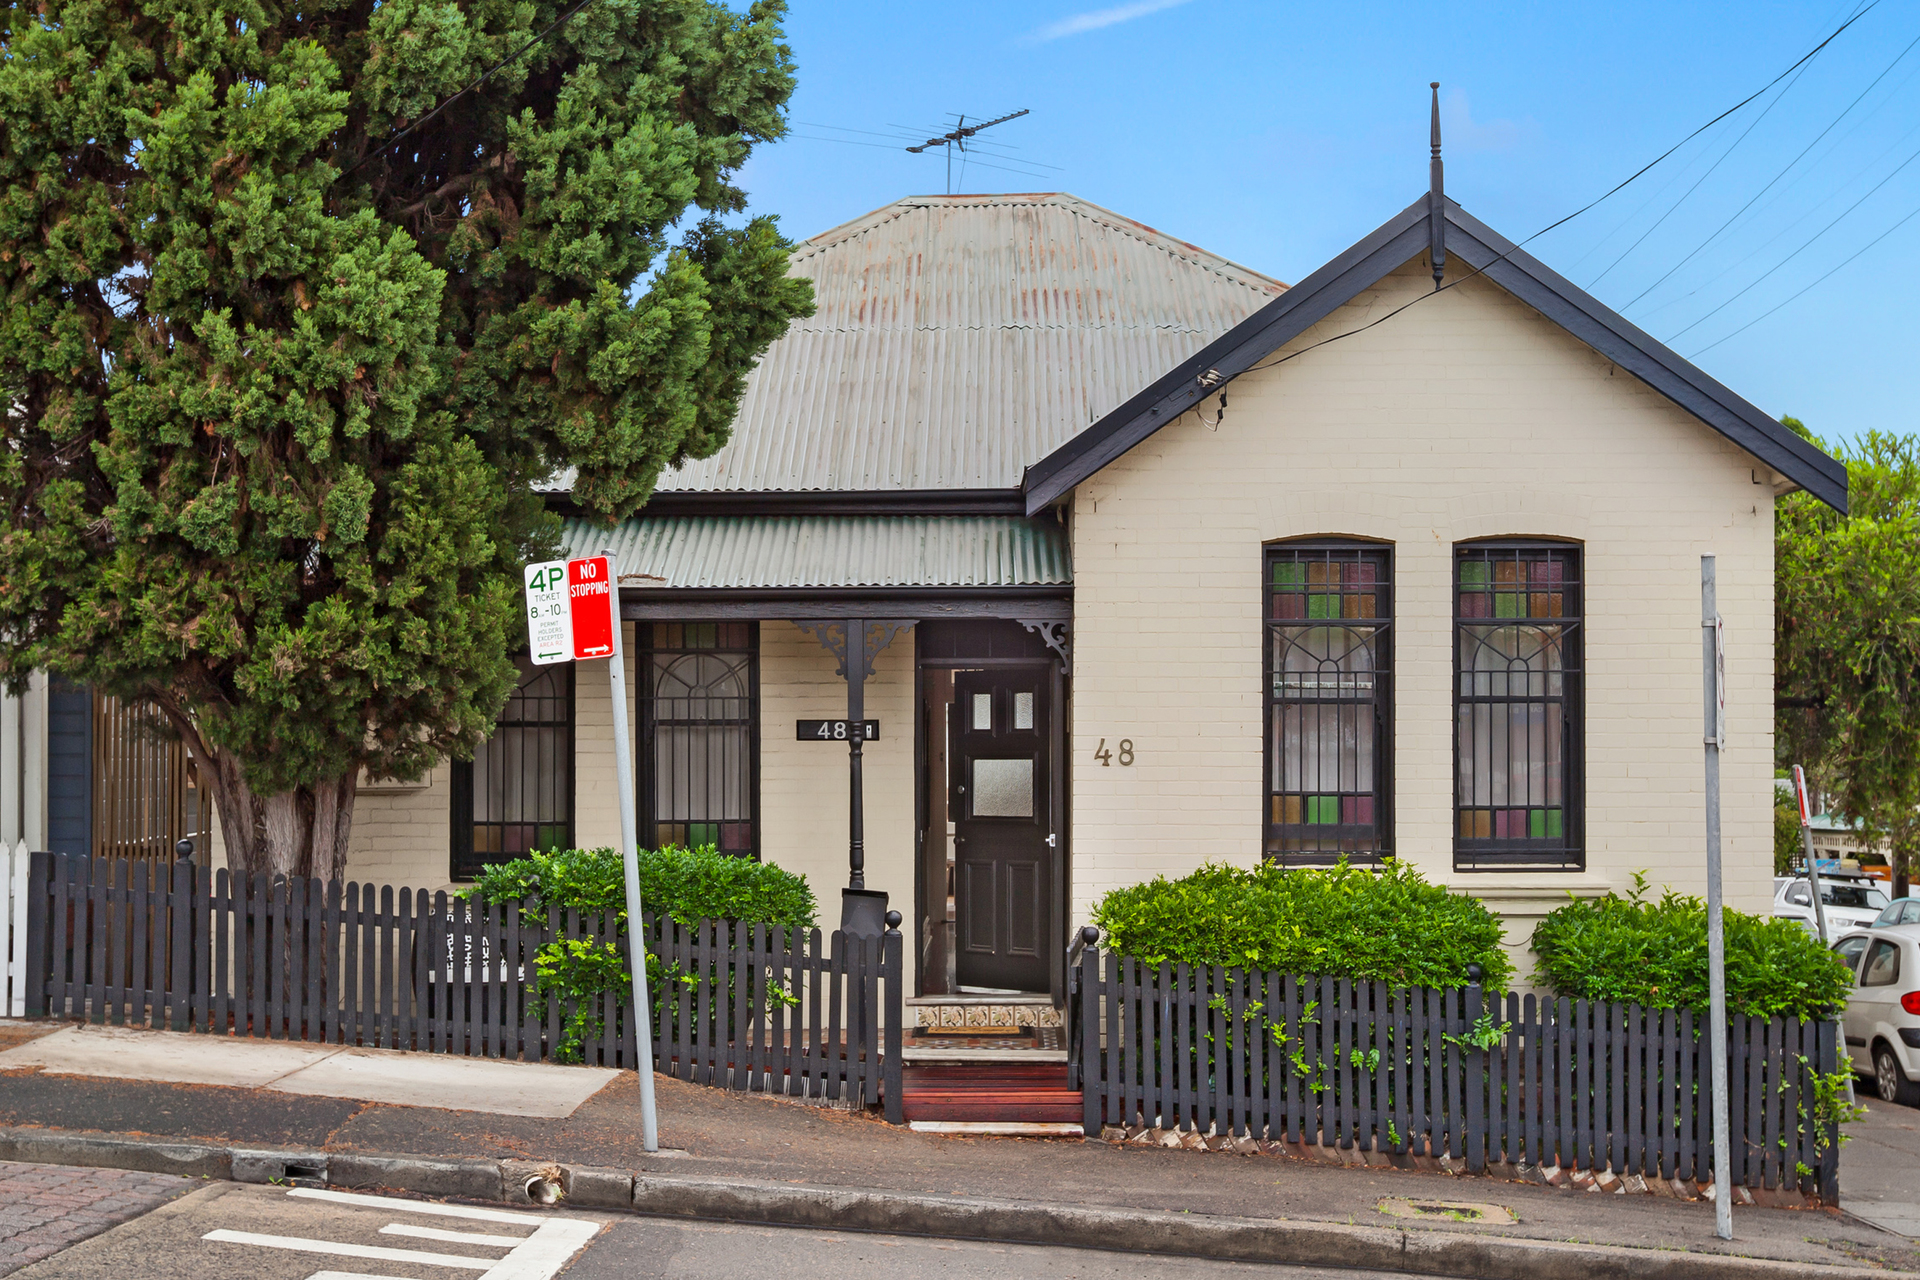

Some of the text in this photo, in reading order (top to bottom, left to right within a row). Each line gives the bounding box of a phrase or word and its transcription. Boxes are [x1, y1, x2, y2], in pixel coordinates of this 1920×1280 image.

[580, 563, 597, 579] NO
[529, 567, 564, 592] 4P
[534, 592, 560, 602] TICKET
[570, 580, 609, 598] STOPPING
[538, 627, 563, 635] HOLDERS
[540, 620, 559, 628] PERMIT
[537, 633, 564, 642] EXCEPTED
[817, 721, 847, 739] 48
[1094, 737, 1135, 766] 48
